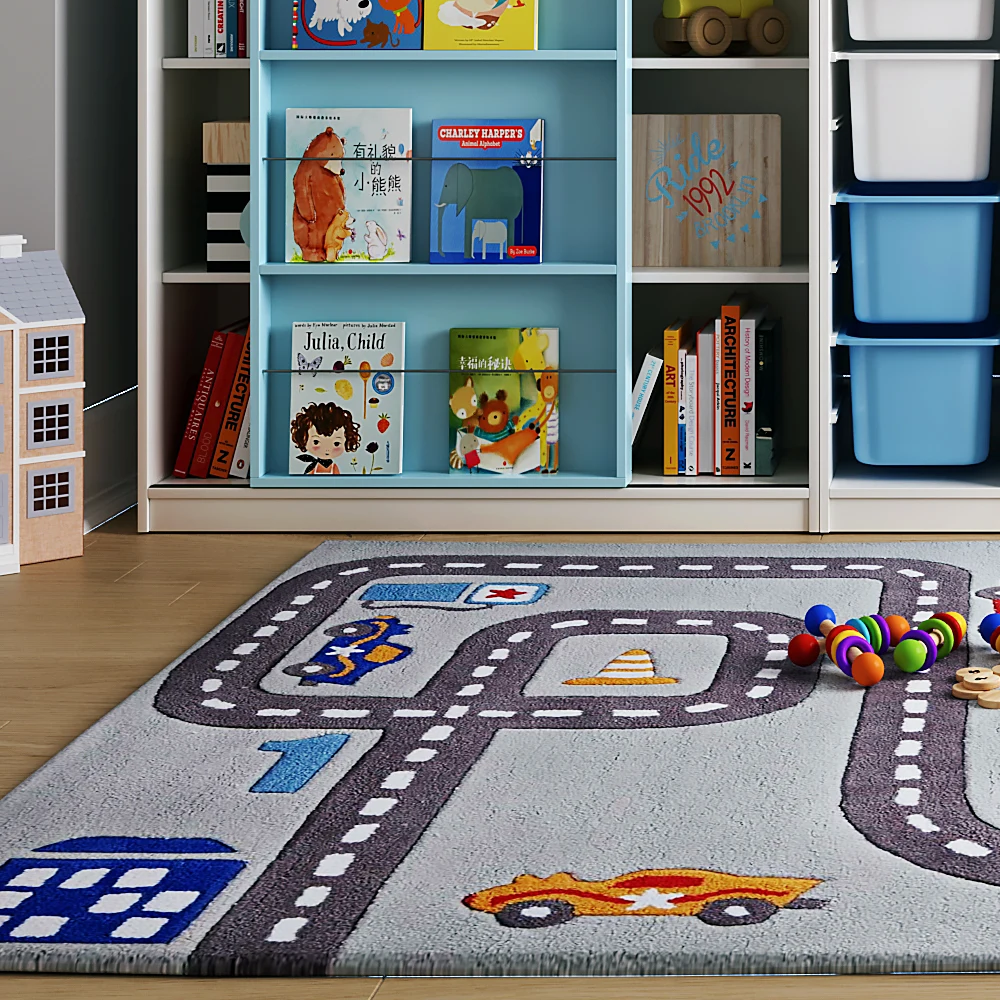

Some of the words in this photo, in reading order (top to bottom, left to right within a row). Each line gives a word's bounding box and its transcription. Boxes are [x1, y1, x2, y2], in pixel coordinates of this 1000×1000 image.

[440, 128, 480, 138] CHARLEY
[481, 128, 523, 138] HARPER'S
[353, 142, 396, 161] 有礼貌
[370, 162, 382, 175] 的
[646, 131, 727, 209] Ride
[353, 172, 402, 196] 小熊熊
[683, 168, 735, 217] 1992
[303, 331, 345, 352] Julia,
[347, 332, 387, 351] Child
[642, 369, 653, 394] CENTURY
[665, 364, 676, 388] ART
[724, 316, 737, 428] ARCHITECTURE
[225, 341, 251, 432] HITECTURE
[188, 368, 215, 441] ANTIQUAIRES
[634, 393, 644, 411] HOUSE
